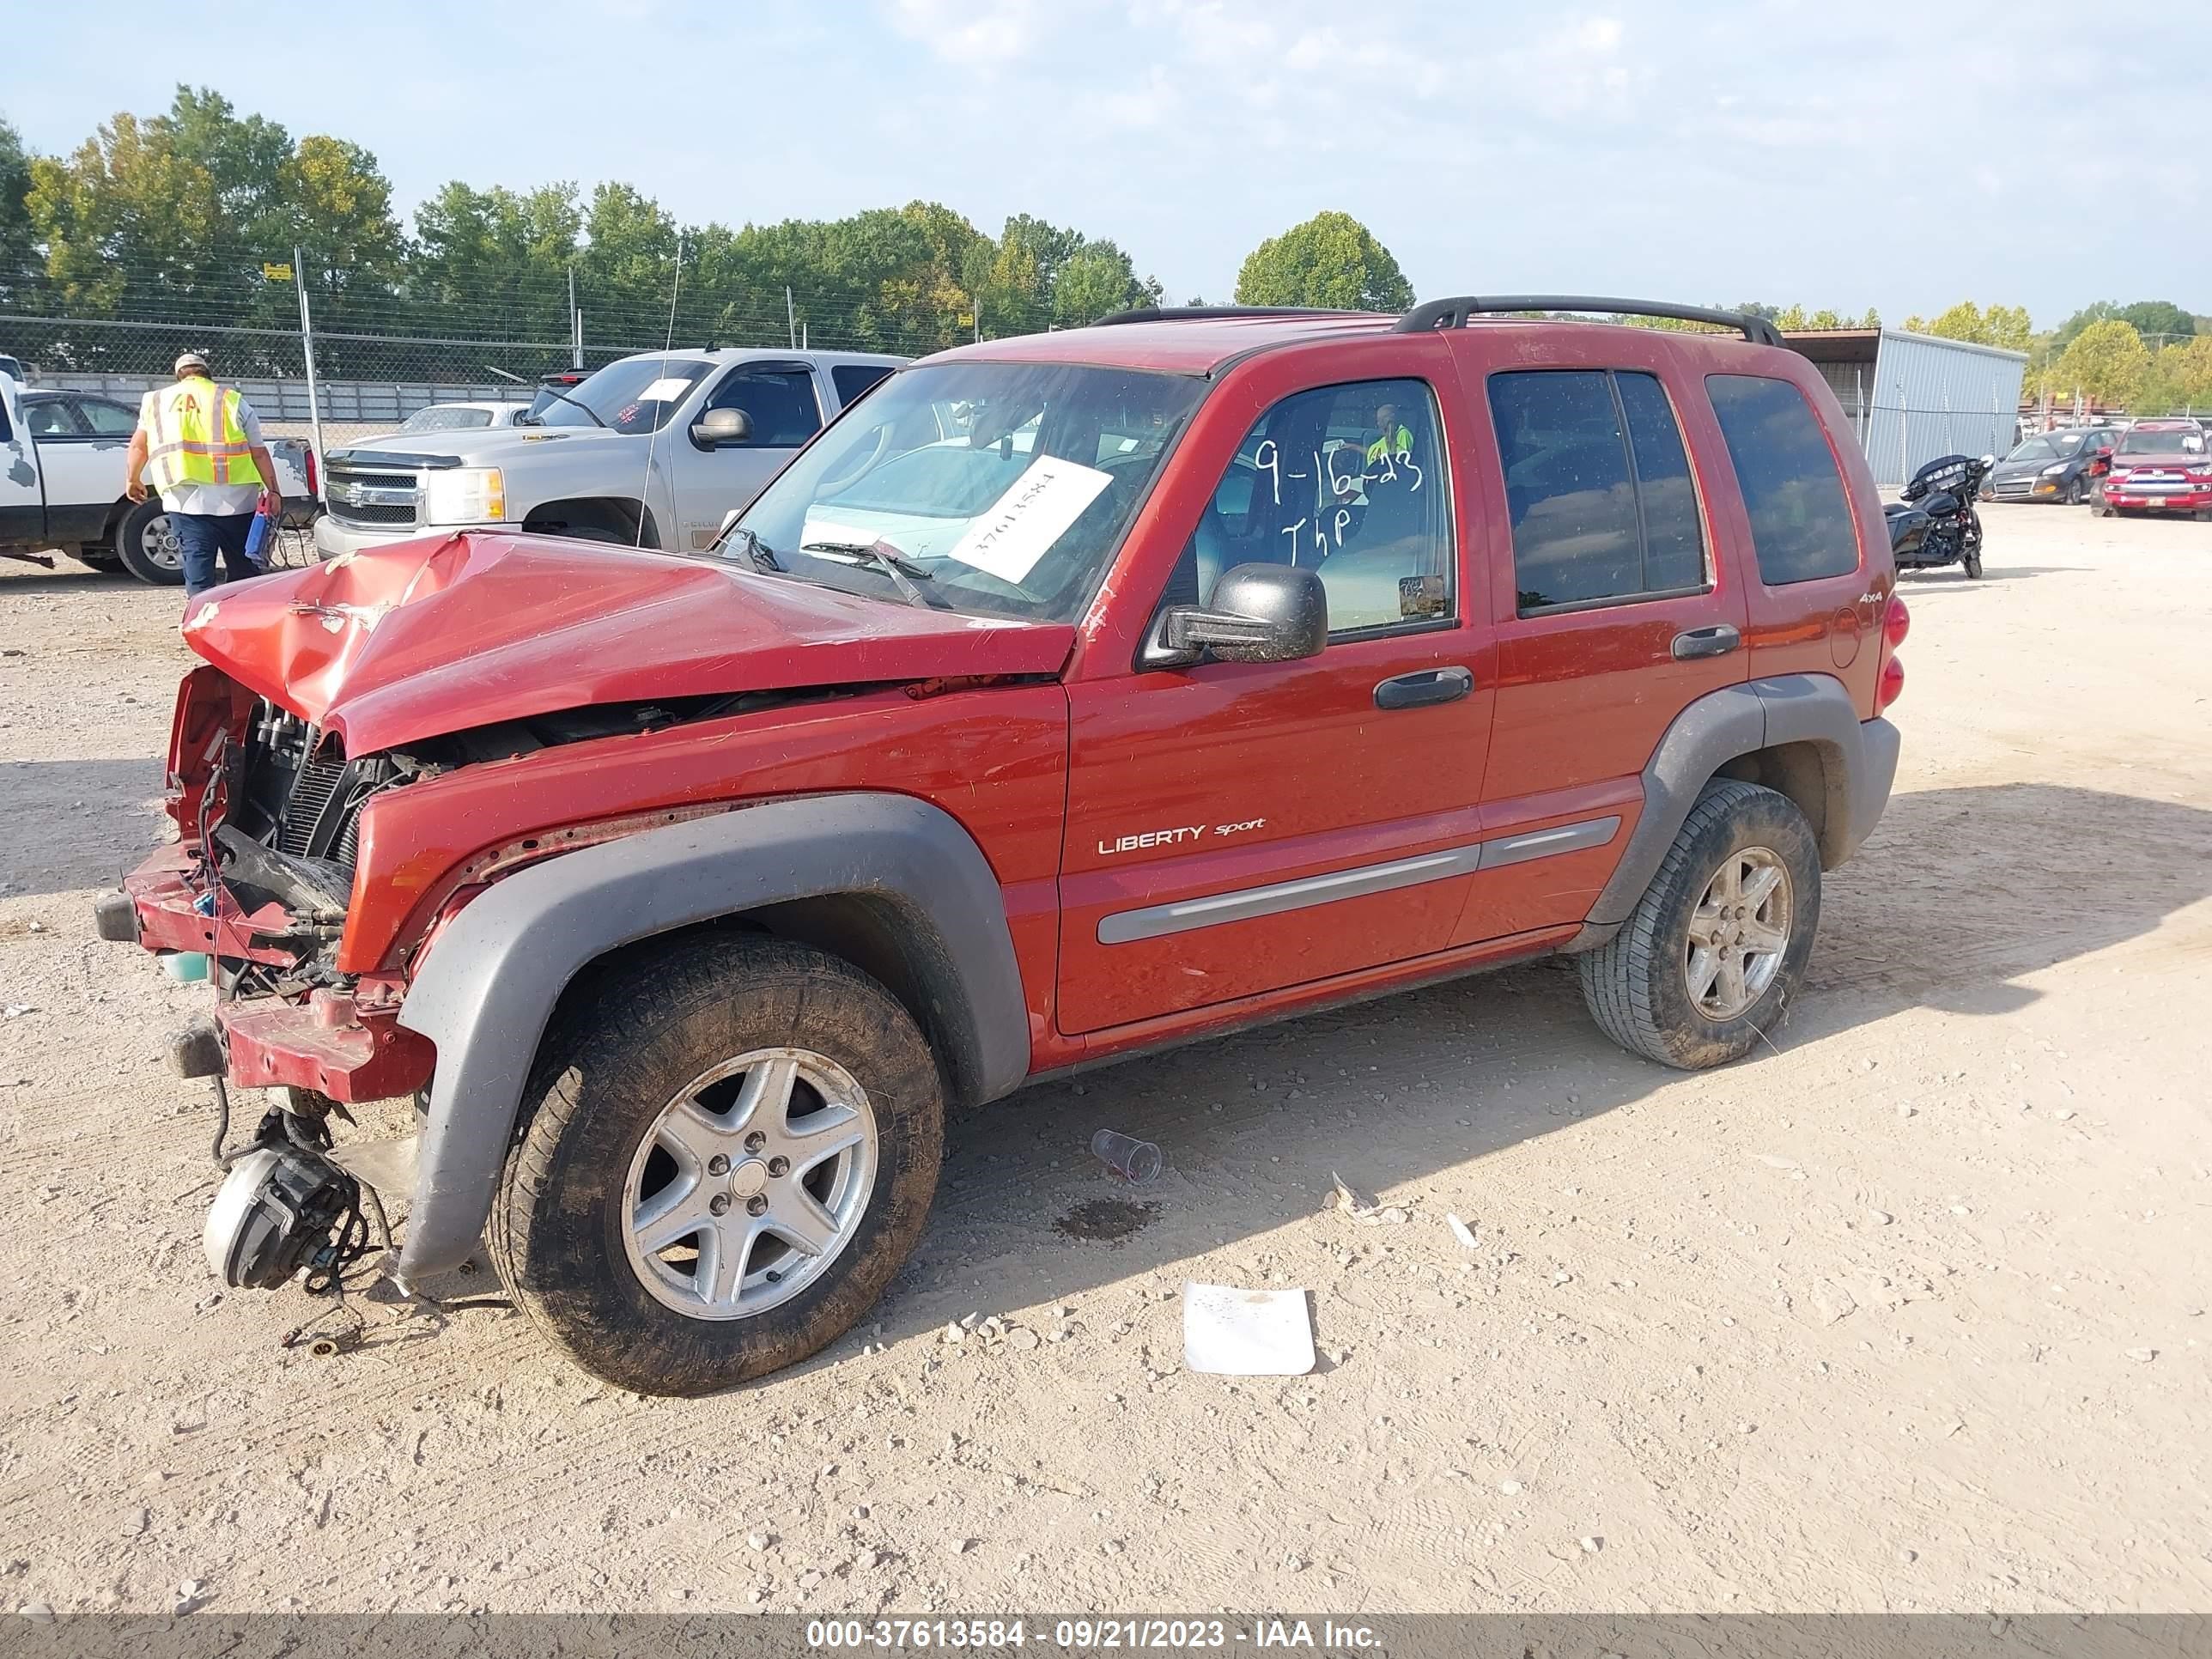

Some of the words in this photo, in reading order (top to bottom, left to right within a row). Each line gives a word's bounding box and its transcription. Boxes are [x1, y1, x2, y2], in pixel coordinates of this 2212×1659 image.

[975, 473, 1055, 555] 37613584
[1098, 824, 1206, 855] LIBERTY
[1213, 817, 1267, 836] sport
